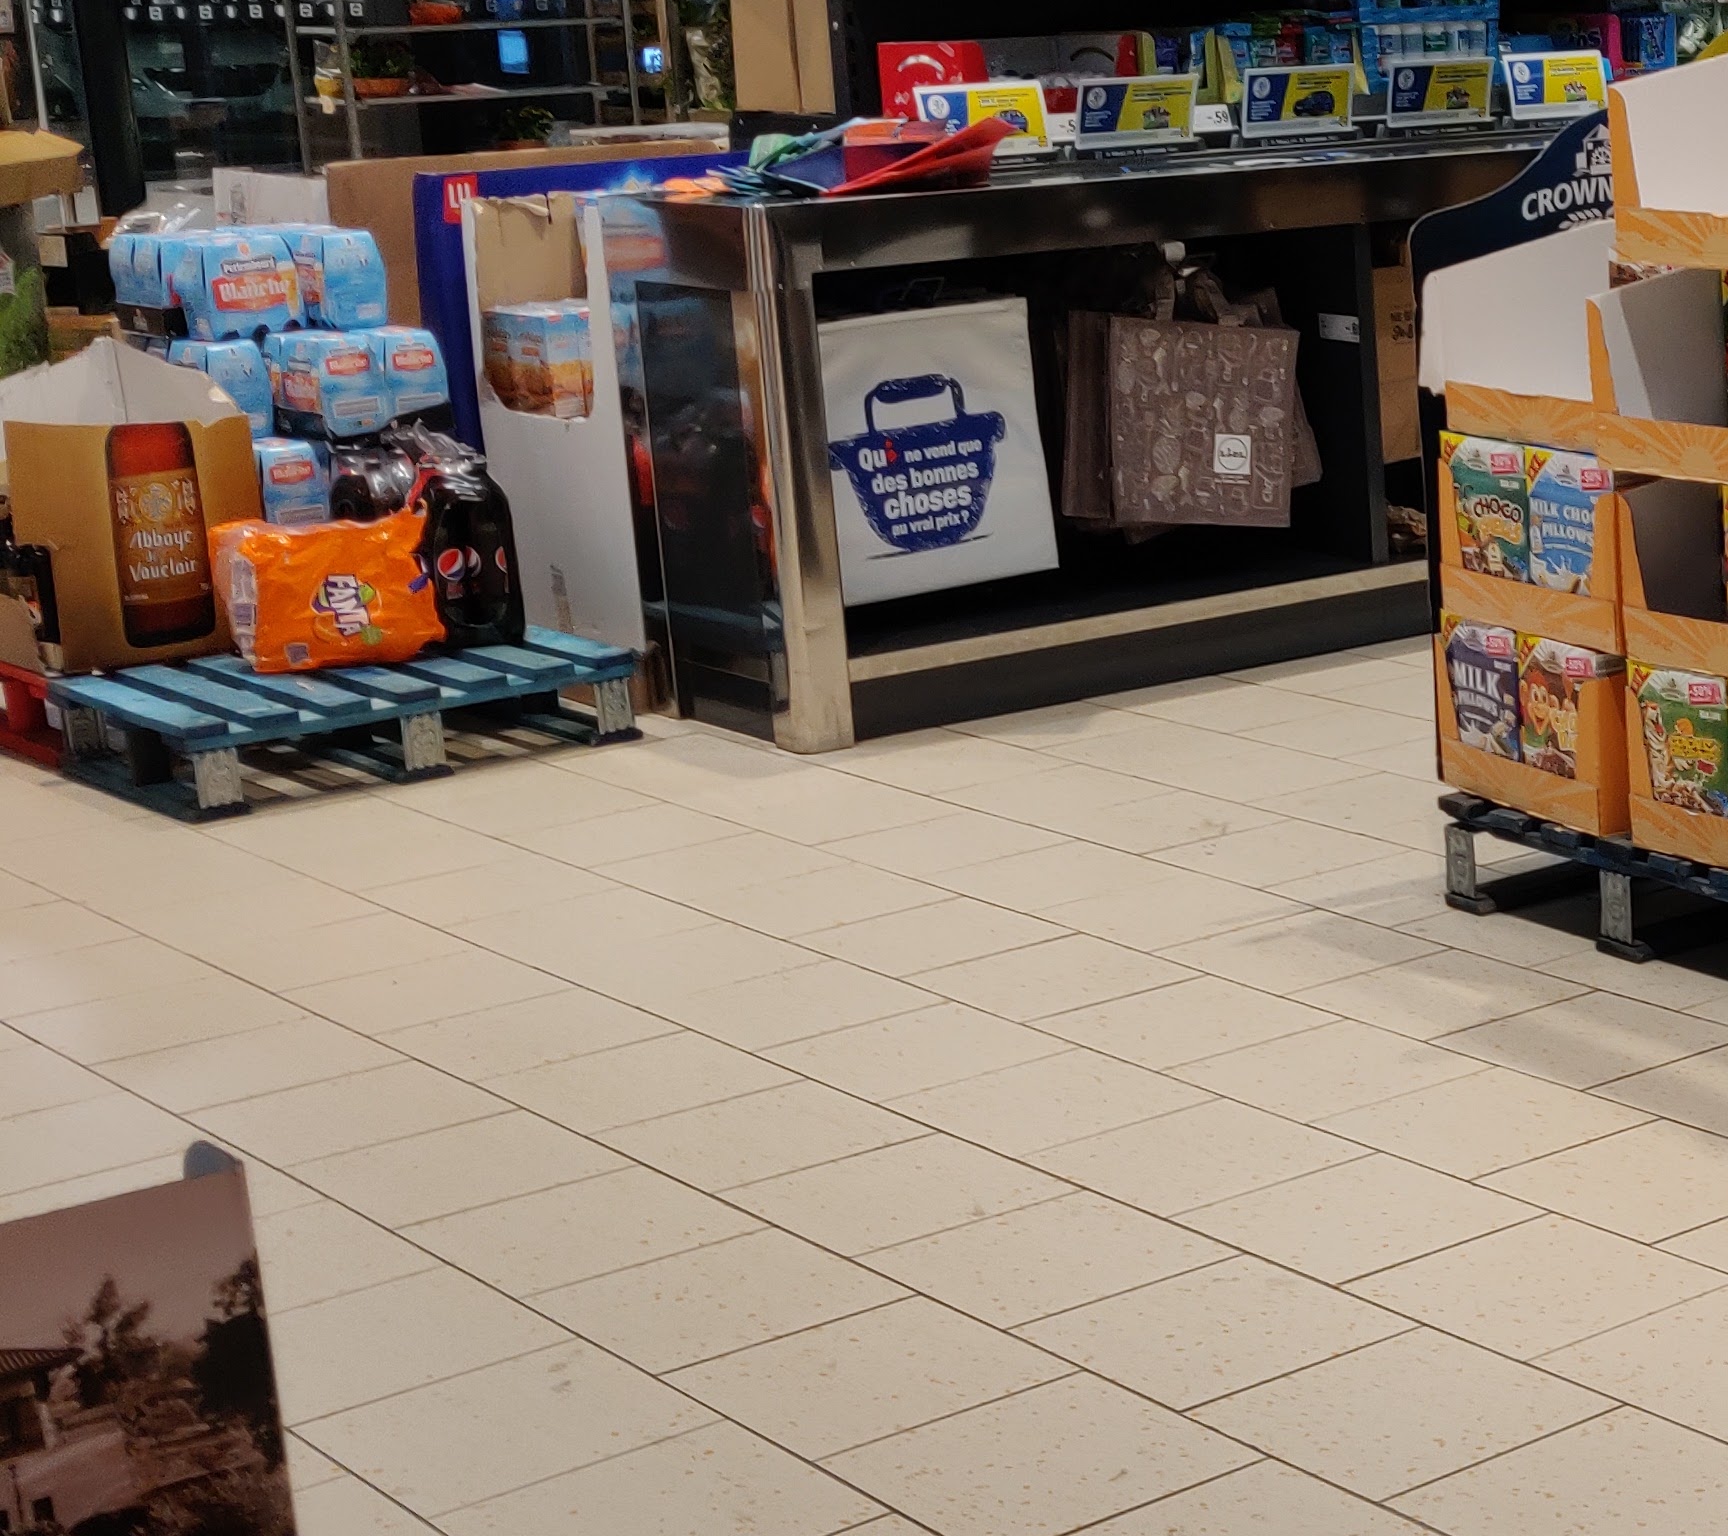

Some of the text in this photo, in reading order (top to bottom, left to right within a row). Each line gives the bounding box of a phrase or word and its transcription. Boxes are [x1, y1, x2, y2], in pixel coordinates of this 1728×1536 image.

[904, 450, 922, 463] ne
[923, 441, 957, 460] vend
[957, 439, 983, 457] que
[871, 462, 980, 495] des bonnes
[884, 485, 973, 520] choses
[1474, 497, 1522, 524] CHOCO
[1563, 505, 1595, 525] CHO
[891, 523, 908, 537] au
[909, 516, 935, 533] vrai
[936, 511, 961, 531] prix
[130, 529, 193, 551] Abbaye
[129, 559, 197, 583] Vauclair
[325, 574, 370, 636] FANTA
[1453, 660, 1502, 703] MILK
